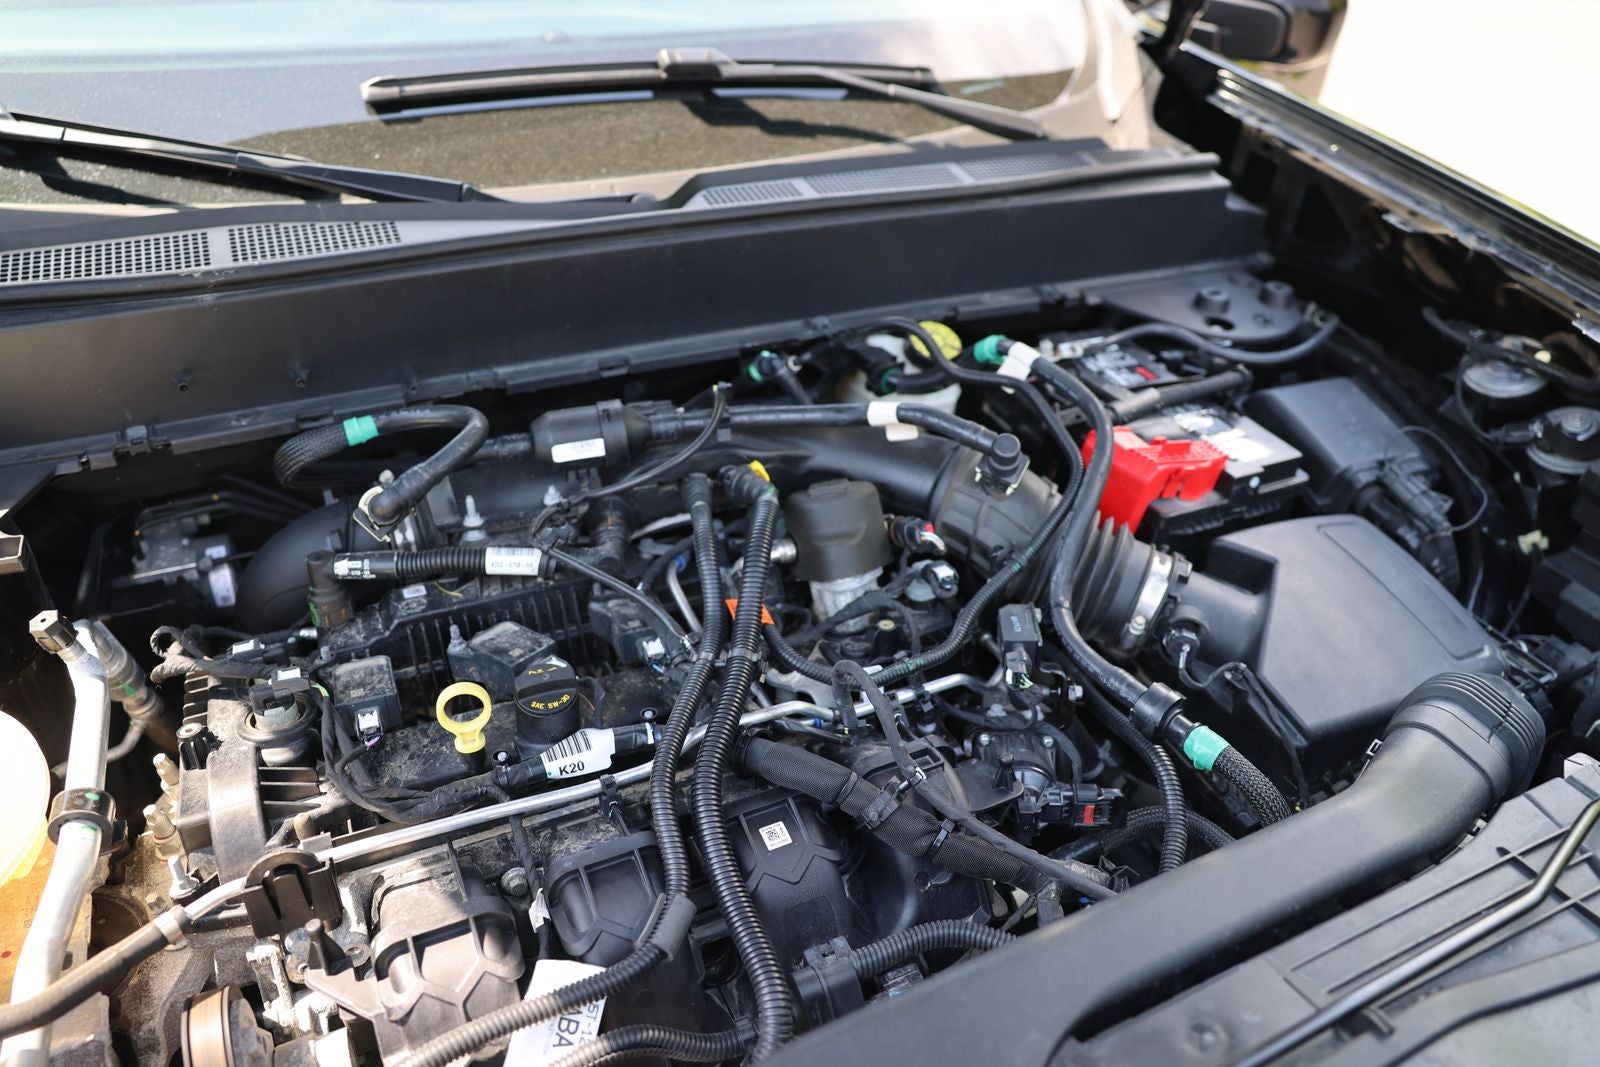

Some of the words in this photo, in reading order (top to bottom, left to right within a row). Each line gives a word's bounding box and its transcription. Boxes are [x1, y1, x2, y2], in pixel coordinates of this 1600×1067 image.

[530, 701, 545, 709] SAE
[547, 694, 570, 709] 5W-30
[559, 761, 585, 776] K20
